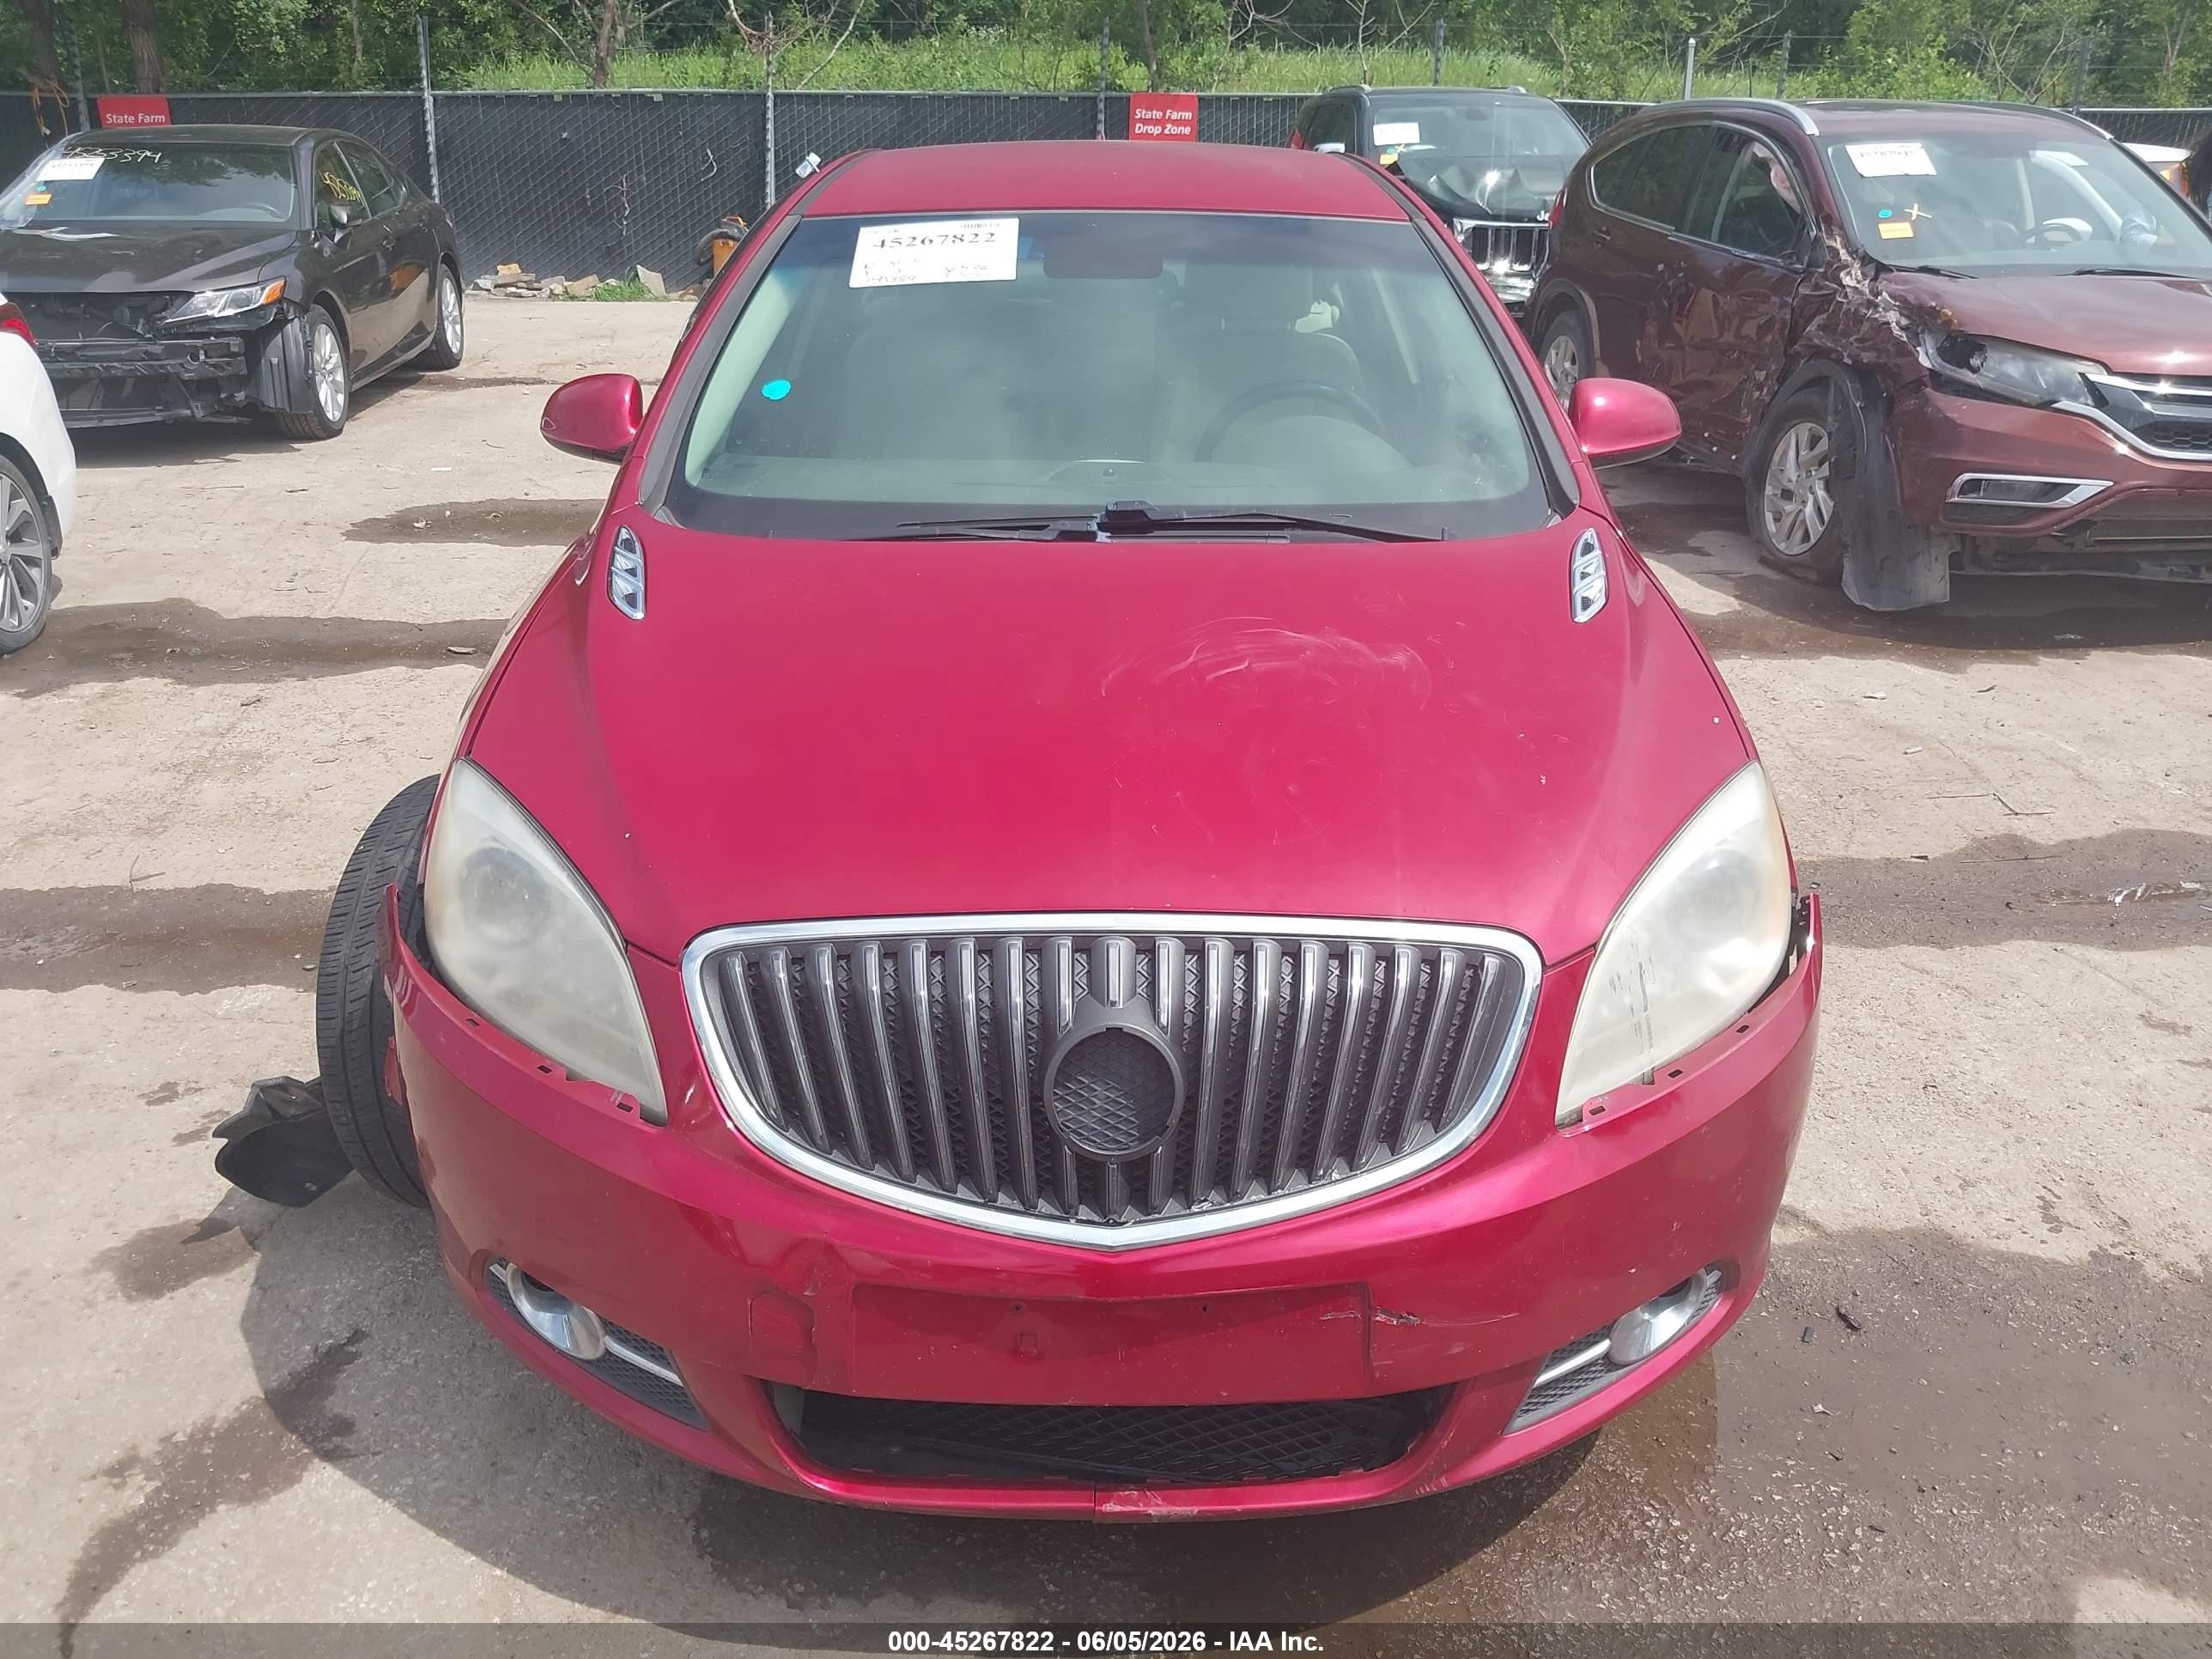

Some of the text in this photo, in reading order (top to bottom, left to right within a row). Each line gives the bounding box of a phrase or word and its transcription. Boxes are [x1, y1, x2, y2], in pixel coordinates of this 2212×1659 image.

[106, 112, 166, 124] State Farm
[1134, 108, 1193, 120] State Farm
[1134, 123, 1191, 137] Drop Zone
[873, 232, 997, 249] 45267822
